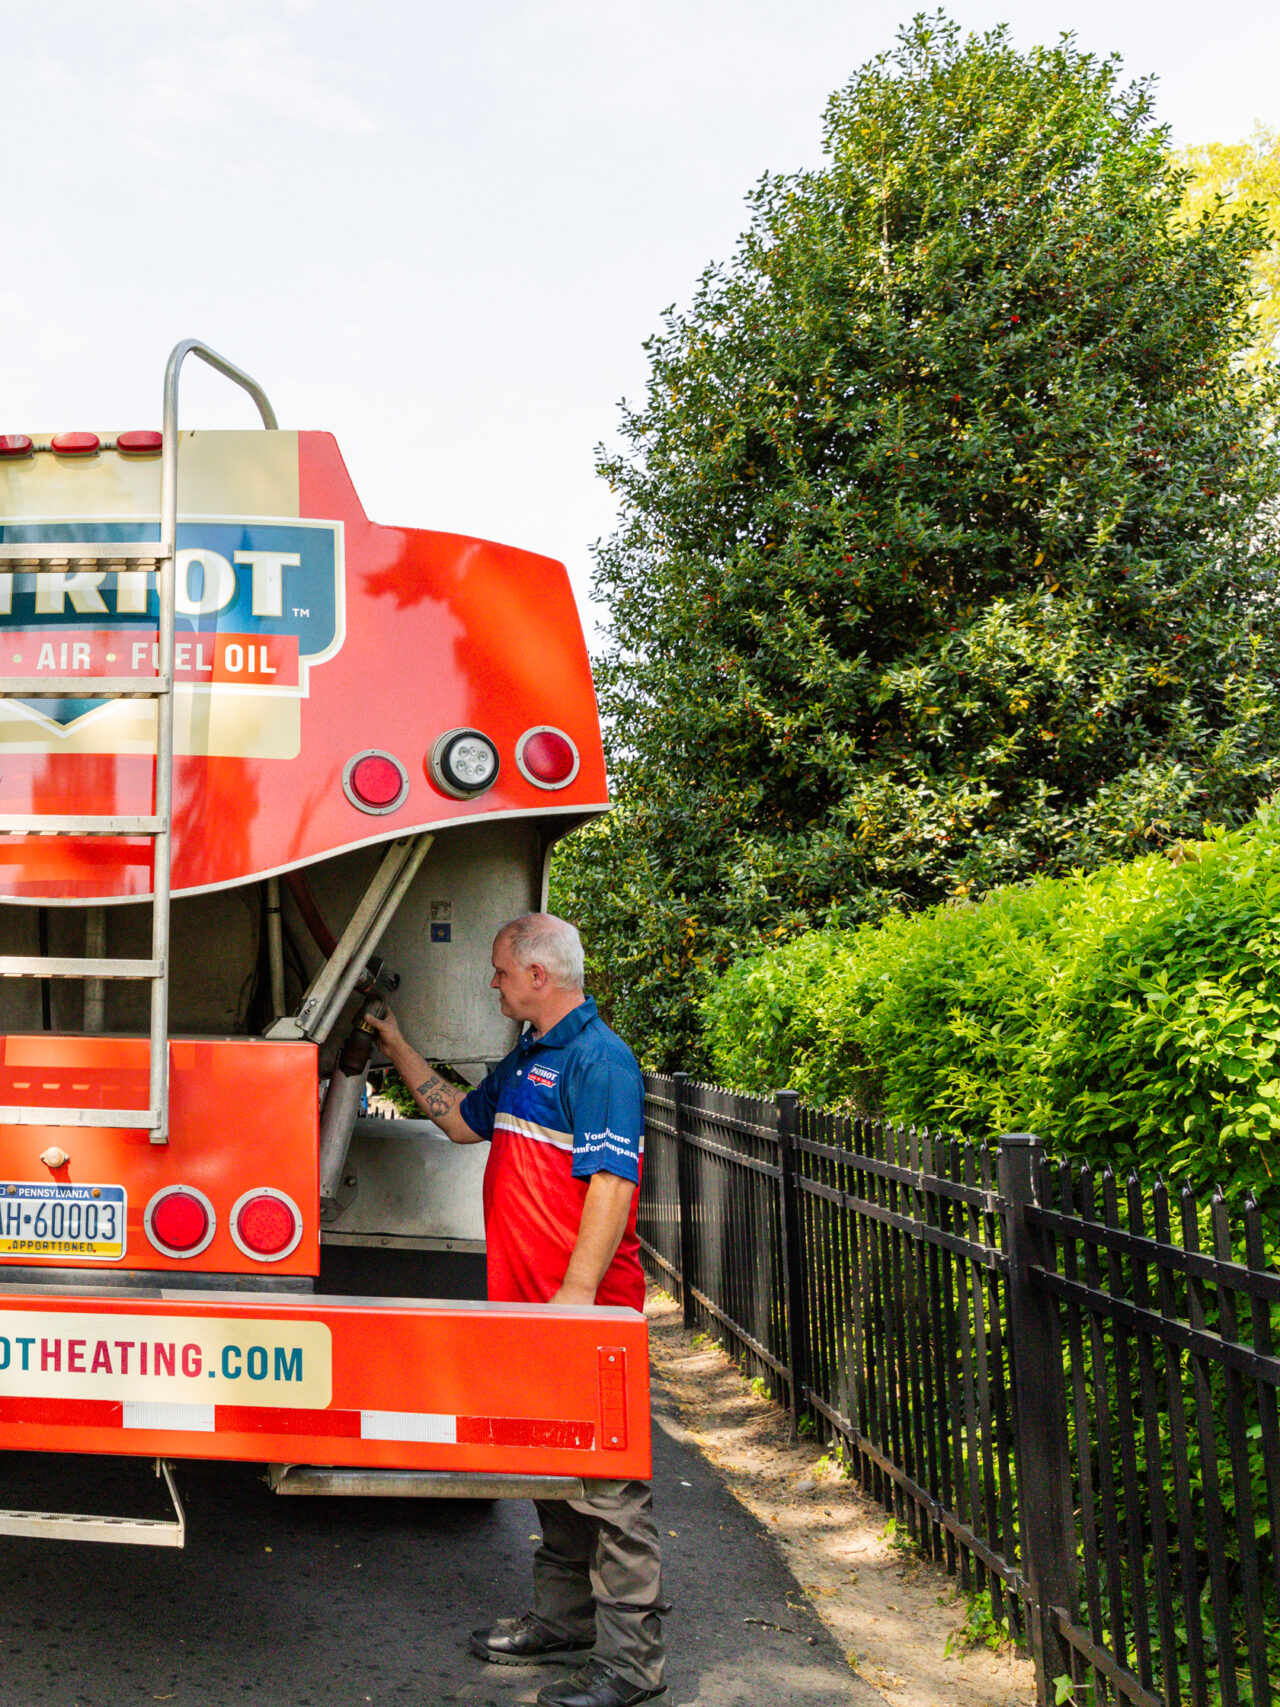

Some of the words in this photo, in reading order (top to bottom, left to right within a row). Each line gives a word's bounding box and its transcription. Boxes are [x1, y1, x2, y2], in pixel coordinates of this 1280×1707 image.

[36, 642, 91, 670] AIR
[224, 643, 277, 674] OIL
[18, 1188, 90, 1199] PENNSYLVANIA
[12, 1240, 93, 1252] APPORTIONED
